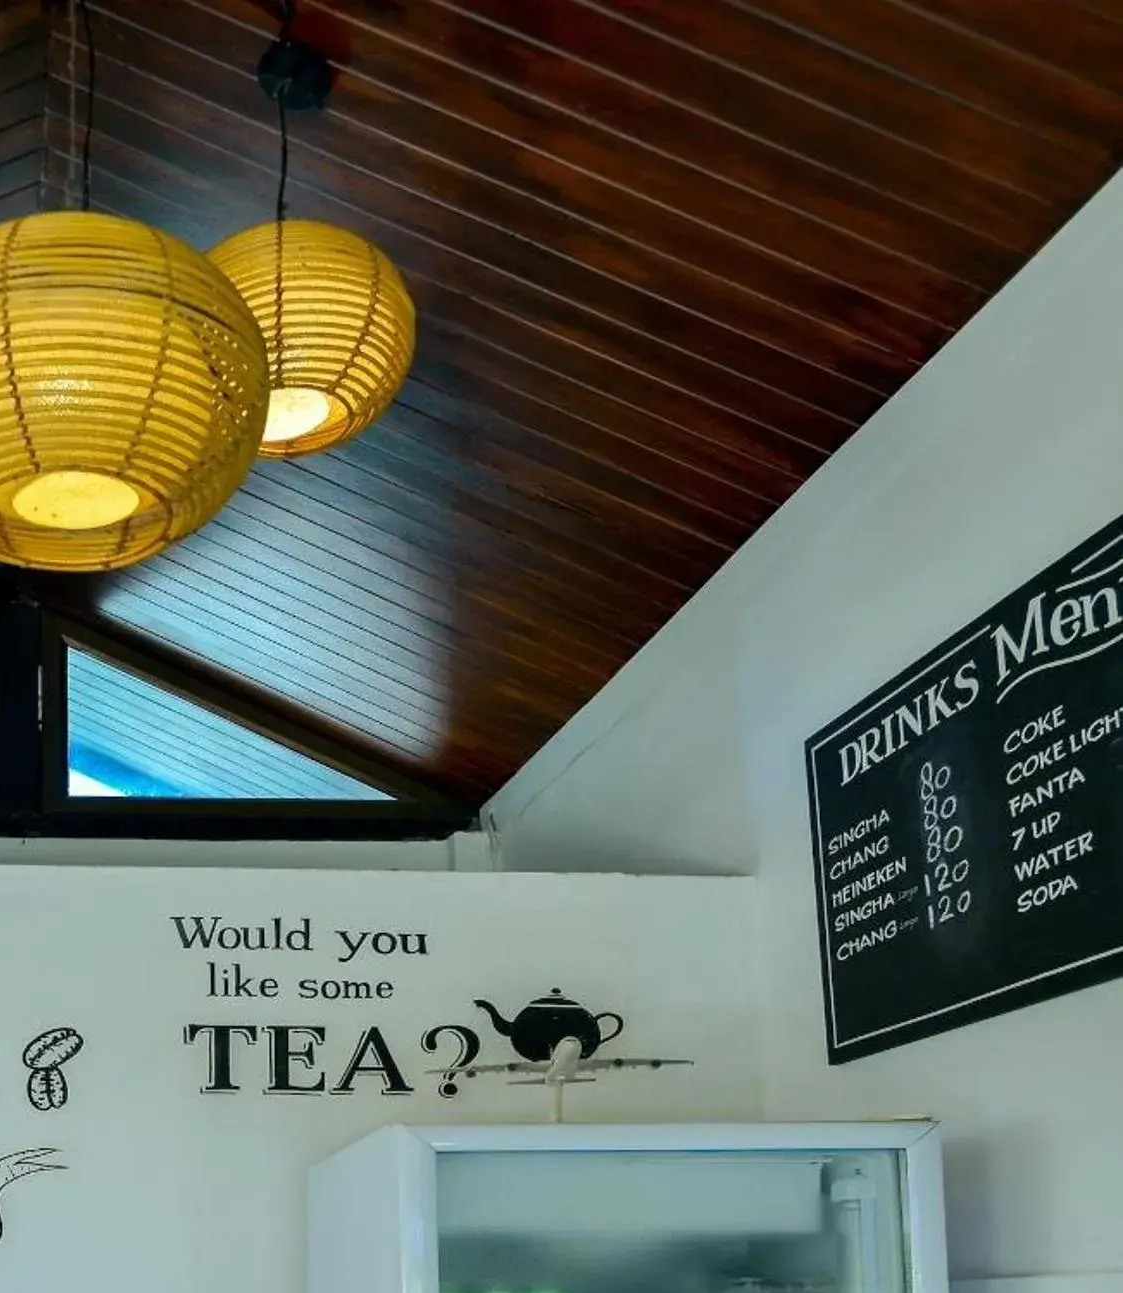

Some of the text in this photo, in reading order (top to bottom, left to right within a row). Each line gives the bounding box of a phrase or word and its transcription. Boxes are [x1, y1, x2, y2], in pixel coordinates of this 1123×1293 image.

[838, 577, 1123, 787] DRINKS Men
[1003, 704, 1066, 754] COKE
[1006, 739, 1067, 785] COKE
[828, 761, 951, 855] SINGHA 80
[1008, 766, 1086, 818] FANTA
[829, 795, 957, 880] CHANG 80
[1011, 811, 1061, 850] 7 UP
[1014, 830, 1093, 882] WATER
[831, 825, 963, 908] HEINEKEN 80
[834, 892, 895, 932] SINGHA
[924, 859, 969, 897] 120
[1017, 874, 1078, 913] SODA
[169, 916, 430, 963] Would you
[836, 919, 898, 961] CHANG
[928, 890, 971, 930] 120
[206, 961, 394, 1001] like some
[183, 1024, 481, 1099] TEA?
